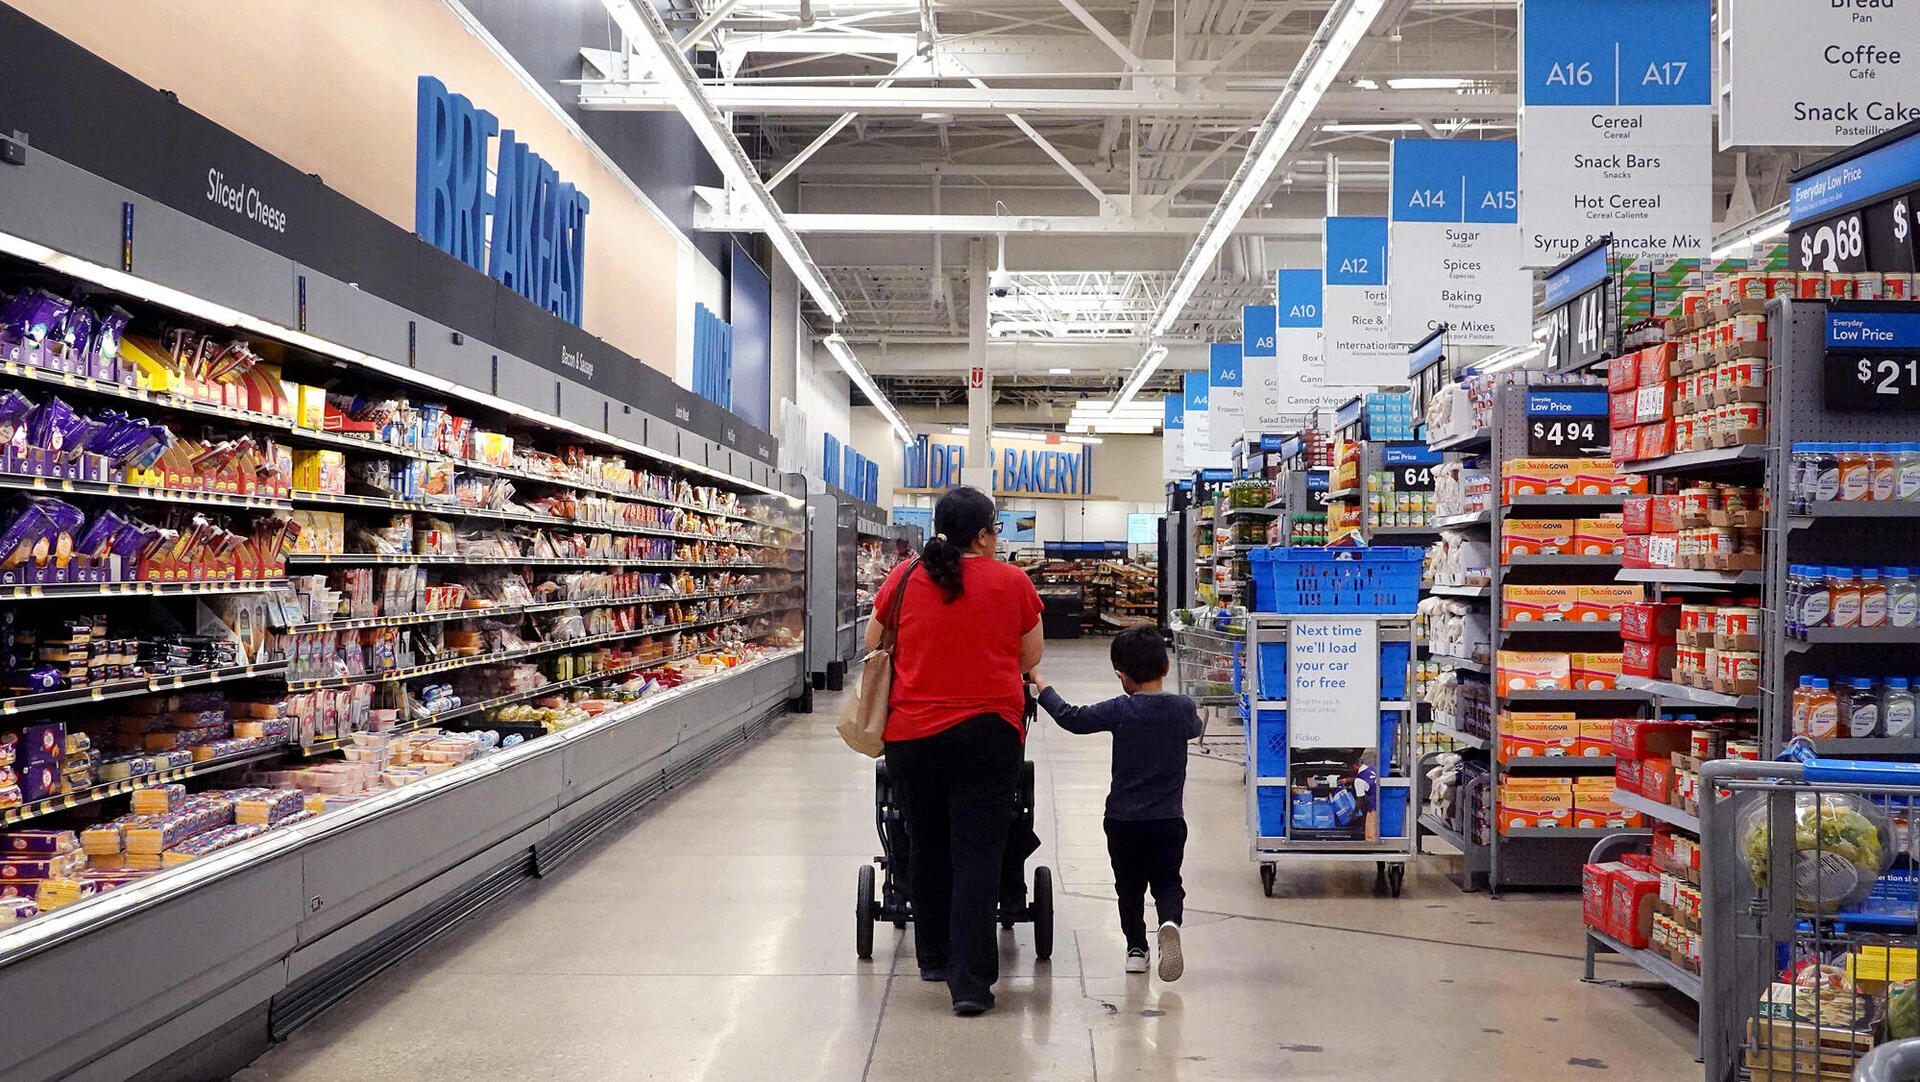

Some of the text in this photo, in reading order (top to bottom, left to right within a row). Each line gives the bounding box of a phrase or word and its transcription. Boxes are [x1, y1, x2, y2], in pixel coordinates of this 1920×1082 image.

[1852, 13, 1873, 23] Pan
[1824, 45, 1901, 64] Coffee
[1545, 62, 1593, 86] A16
[1642, 62, 1688, 86] A17
[1849, 68, 1876, 79] Café
[1794, 102, 1858, 121] Snack
[1591, 114, 1643, 128] Cereal
[1604, 131, 1631, 139] Cereal
[1574, 154, 1661, 168] Snack Bars
[1603, 171, 1632, 179] Snacks
[1796, 179, 1826, 202] Everyday
[1827, 175, 1842, 190] Low
[1843, 168, 1862, 184] Price
[206, 167, 287, 234] Sliced Cheese
[416, 75, 590, 329] BREAKFAST
[1408, 190, 1446, 208] A14
[1480, 191, 1517, 209] A15
[1574, 194, 1661, 208] Hot Cereal
[1586, 211, 1649, 219] Cereal Caliente
[1445, 229, 1480, 242] Sugar
[1534, 234, 1579, 252] Syrup
[1611, 234, 1667, 248] ancake
[1672, 234, 1701, 248] Mix
[1340, 258, 1368, 273] A12
[1443, 258, 1481, 272] Spices
[1364, 290, 1388, 300] Torti
[1442, 290, 1482, 304] Baking
[1290, 304, 1316, 318] A10
[1352, 316, 1384, 325] Rice &
[1461, 320, 1496, 332] Mixes
[1833, 319, 1864, 328] Everyday
[1833, 328, 1894, 340] Low Price
[1256, 336, 1274, 349] A8
[1336, 341, 1401, 350] International
[561, 346, 576, 369] Bacon
[580, 353, 594, 380] Sausage
[1302, 354, 1320, 362] Box
[1220, 370, 1236, 380] A6
[1300, 375, 1323, 384] Cann
[1193, 396, 1208, 405] A4
[1288, 396, 1350, 407] Canned Veget
[1531, 402, 1572, 411] Low Price
[1258, 416, 1279, 424] Salad
[1004, 447, 1082, 494] BAKERY
[1296, 624, 1362, 636] Next time
[1296, 642, 1357, 654] we'll load
[1296, 661, 1350, 674] your car
[1296, 676, 1346, 688] for free
[1296, 733, 1320, 742] Pickup
